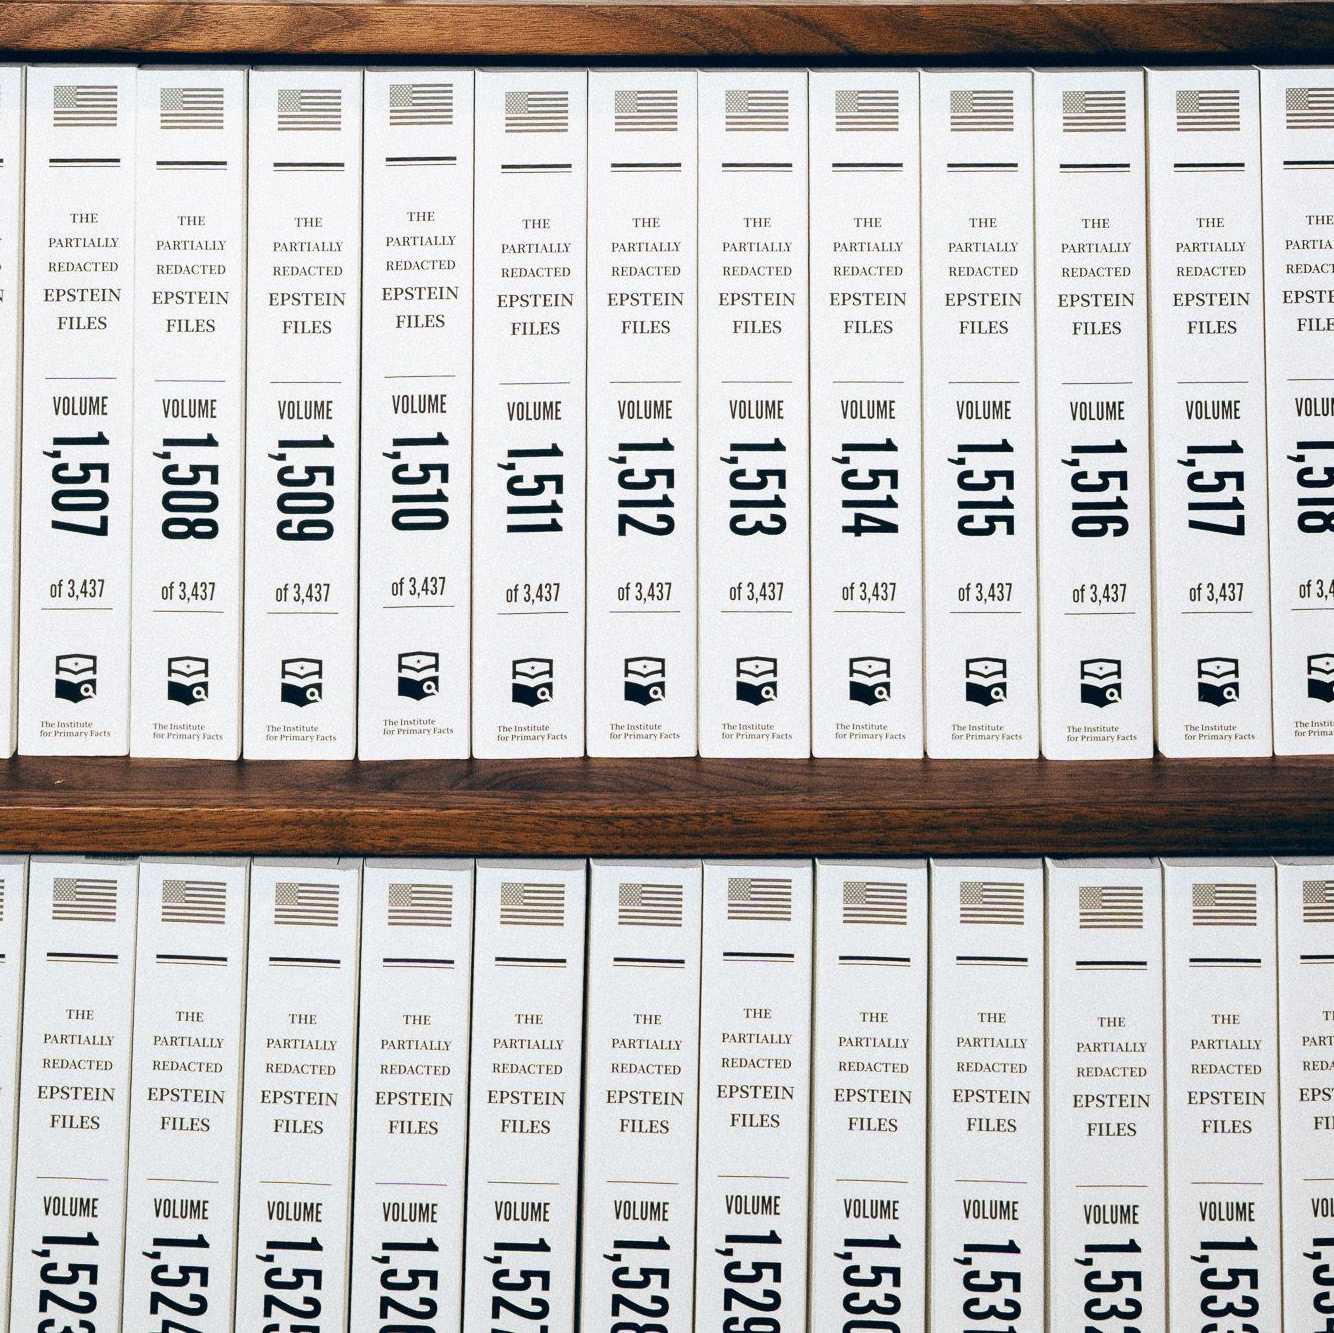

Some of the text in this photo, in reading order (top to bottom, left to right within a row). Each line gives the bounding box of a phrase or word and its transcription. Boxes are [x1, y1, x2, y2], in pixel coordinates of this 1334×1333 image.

[1081, 218, 1108, 229] THE
[1061, 242, 1129, 254] PARTIALLY
[1061, 266, 1132, 278] REDACTED
[1058, 293, 1134, 308] EPSTEIN
[1073, 321, 1122, 336] FILES
[1069, 400, 1125, 422] VOLUME
[42, 431, 110, 537] 1,507
[268, 434, 335, 542] 1,509
[497, 442, 564, 533] 1,511
[720, 437, 787, 537] 1,513
[947, 438, 1015, 537] 1,515
[1061, 439, 1129, 538] 1,516
[1072, 582, 1127, 605] of 3,437
[1066, 725, 1120, 733] The Institute
[1066, 734, 1138, 743] for Primary Facts
[861, 1011, 887, 1023] THE
[838, 1036, 908, 1049] PARTIALLY
[838, 1061, 910, 1074] REDACTED
[834, 1088, 911, 1104] EPSTEIN
[848, 1117, 898, 1132] FILES
[843, 1198, 899, 1221] VOLUME
